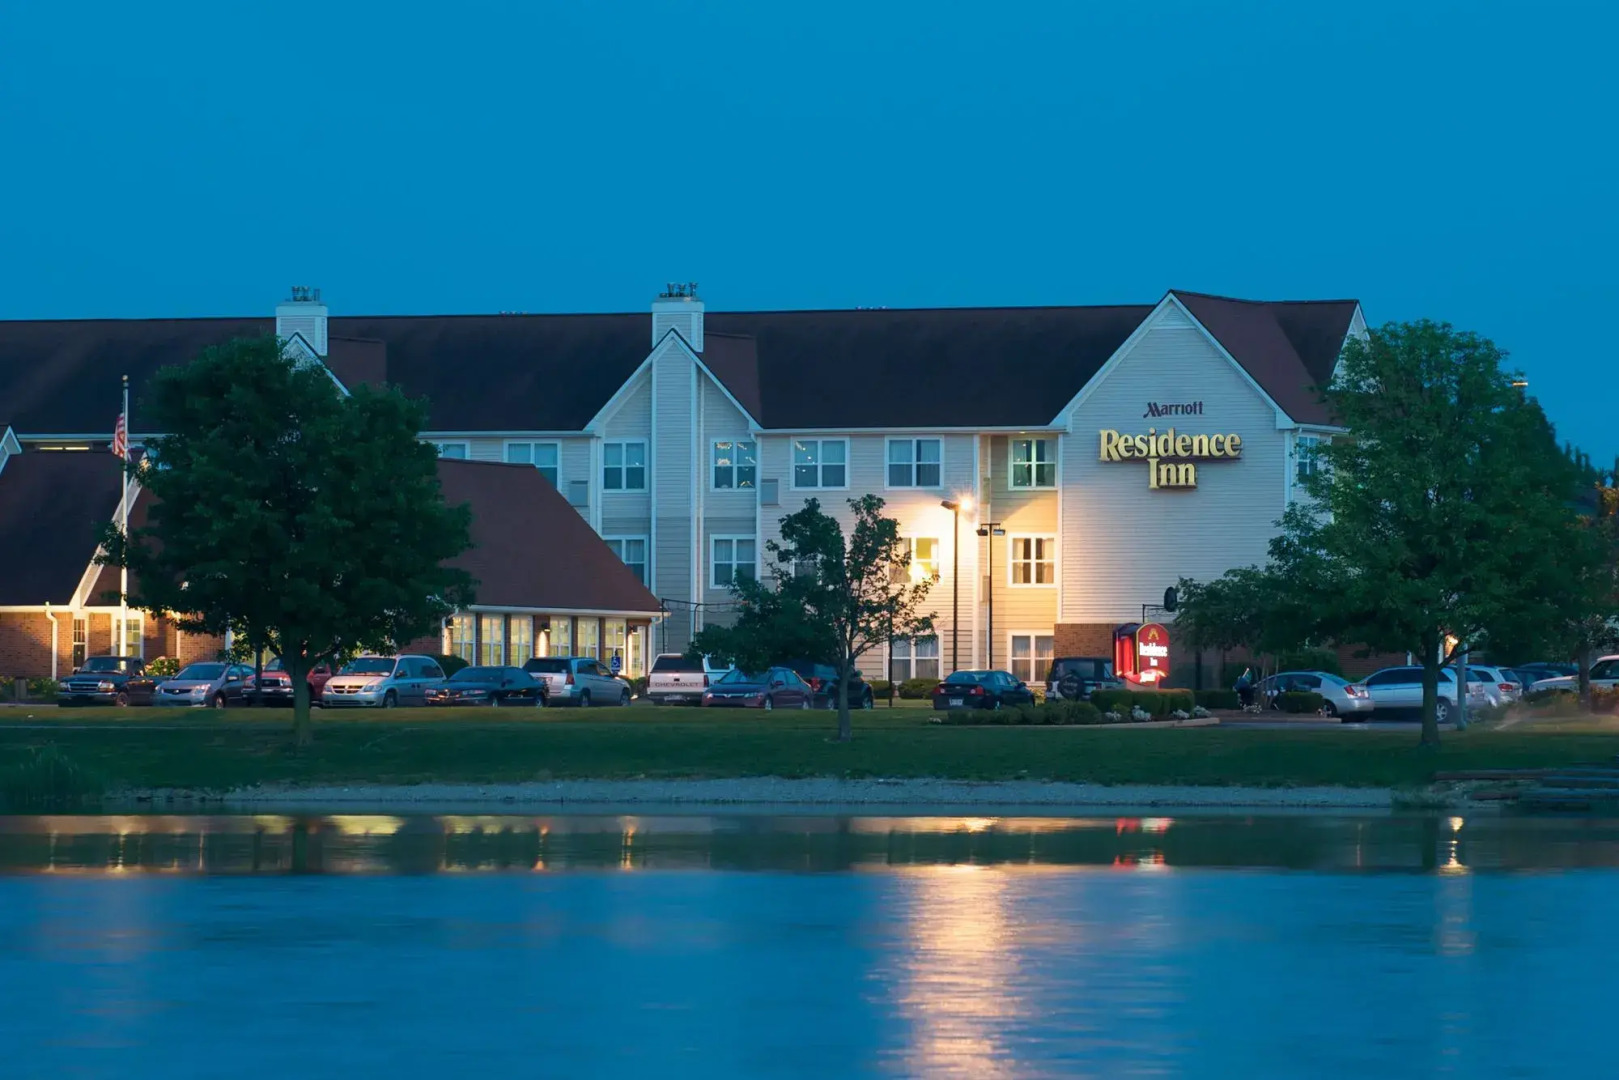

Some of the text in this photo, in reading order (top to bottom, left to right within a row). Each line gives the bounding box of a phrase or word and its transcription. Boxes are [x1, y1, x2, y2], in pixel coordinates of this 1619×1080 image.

[1143, 401, 1203, 418] Marriott
[1099, 427, 1241, 461] Residence
[1147, 458, 1196, 489] Inn
